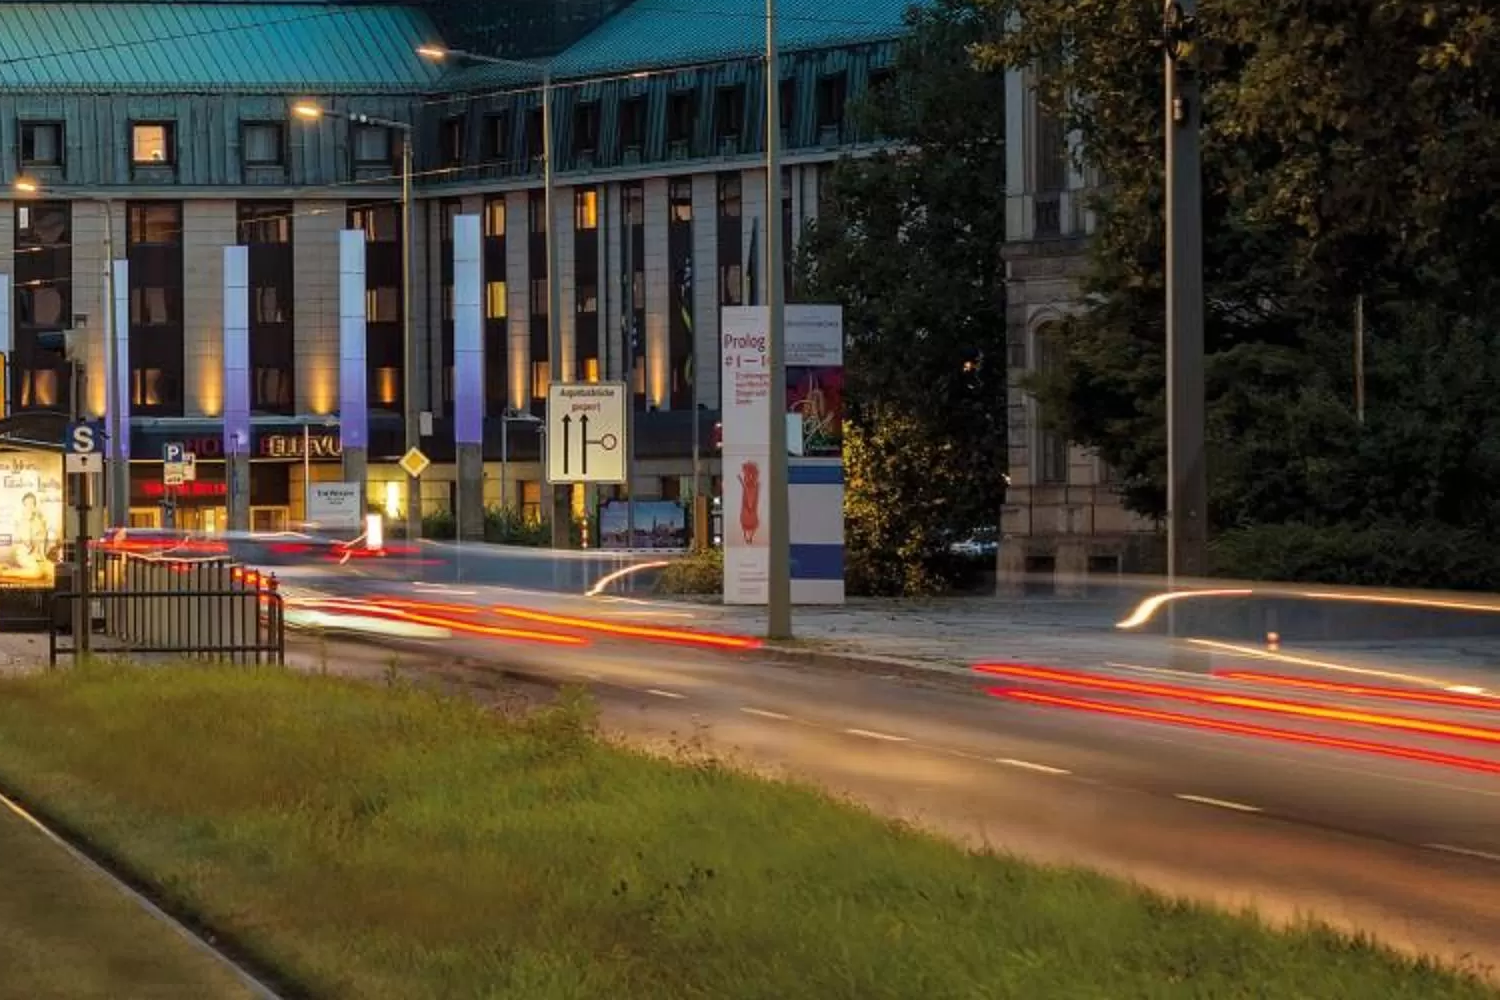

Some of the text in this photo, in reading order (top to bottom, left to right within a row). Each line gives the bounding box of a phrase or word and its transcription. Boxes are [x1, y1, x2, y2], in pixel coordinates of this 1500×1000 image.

[724, 333, 766, 353] Prolog
[73, 426, 94, 452] S
[167, 445, 179, 461] P
